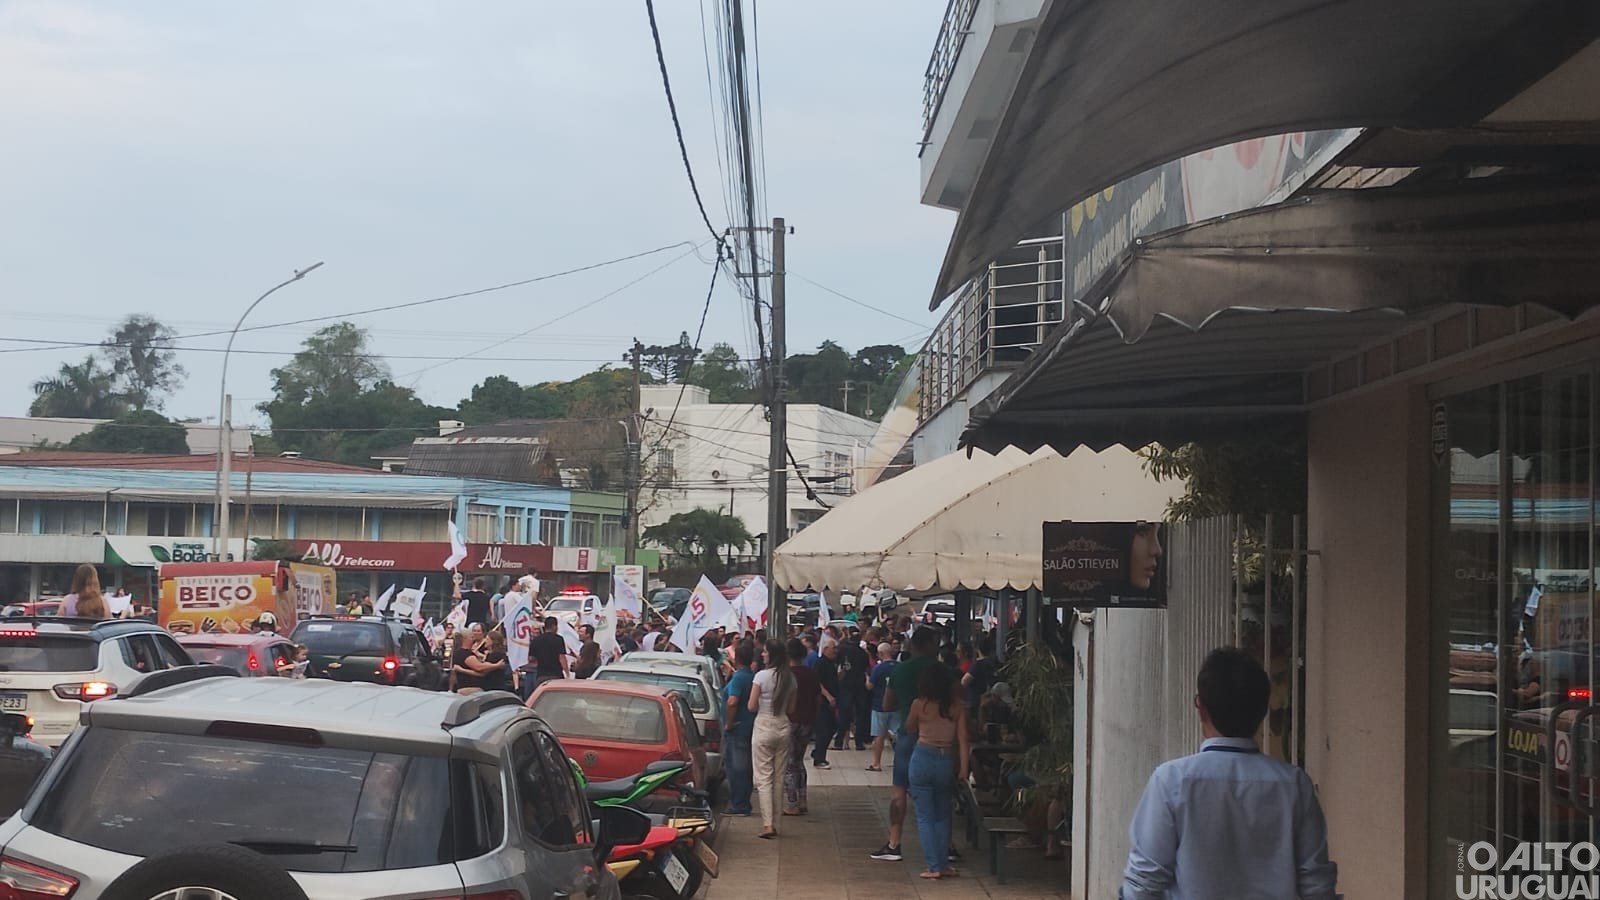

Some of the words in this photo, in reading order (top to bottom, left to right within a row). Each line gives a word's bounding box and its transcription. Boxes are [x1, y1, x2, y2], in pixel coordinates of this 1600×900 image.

[301, 542, 344, 566] All
[344, 556, 395, 567] Telecom
[478, 546, 503, 568] All
[1043, 556, 1076, 570] SALÃO
[1077, 558, 1119, 570] STIEVEN
[180, 585, 252, 606] BEIÇO
[1507, 727, 1538, 755] LOJA
